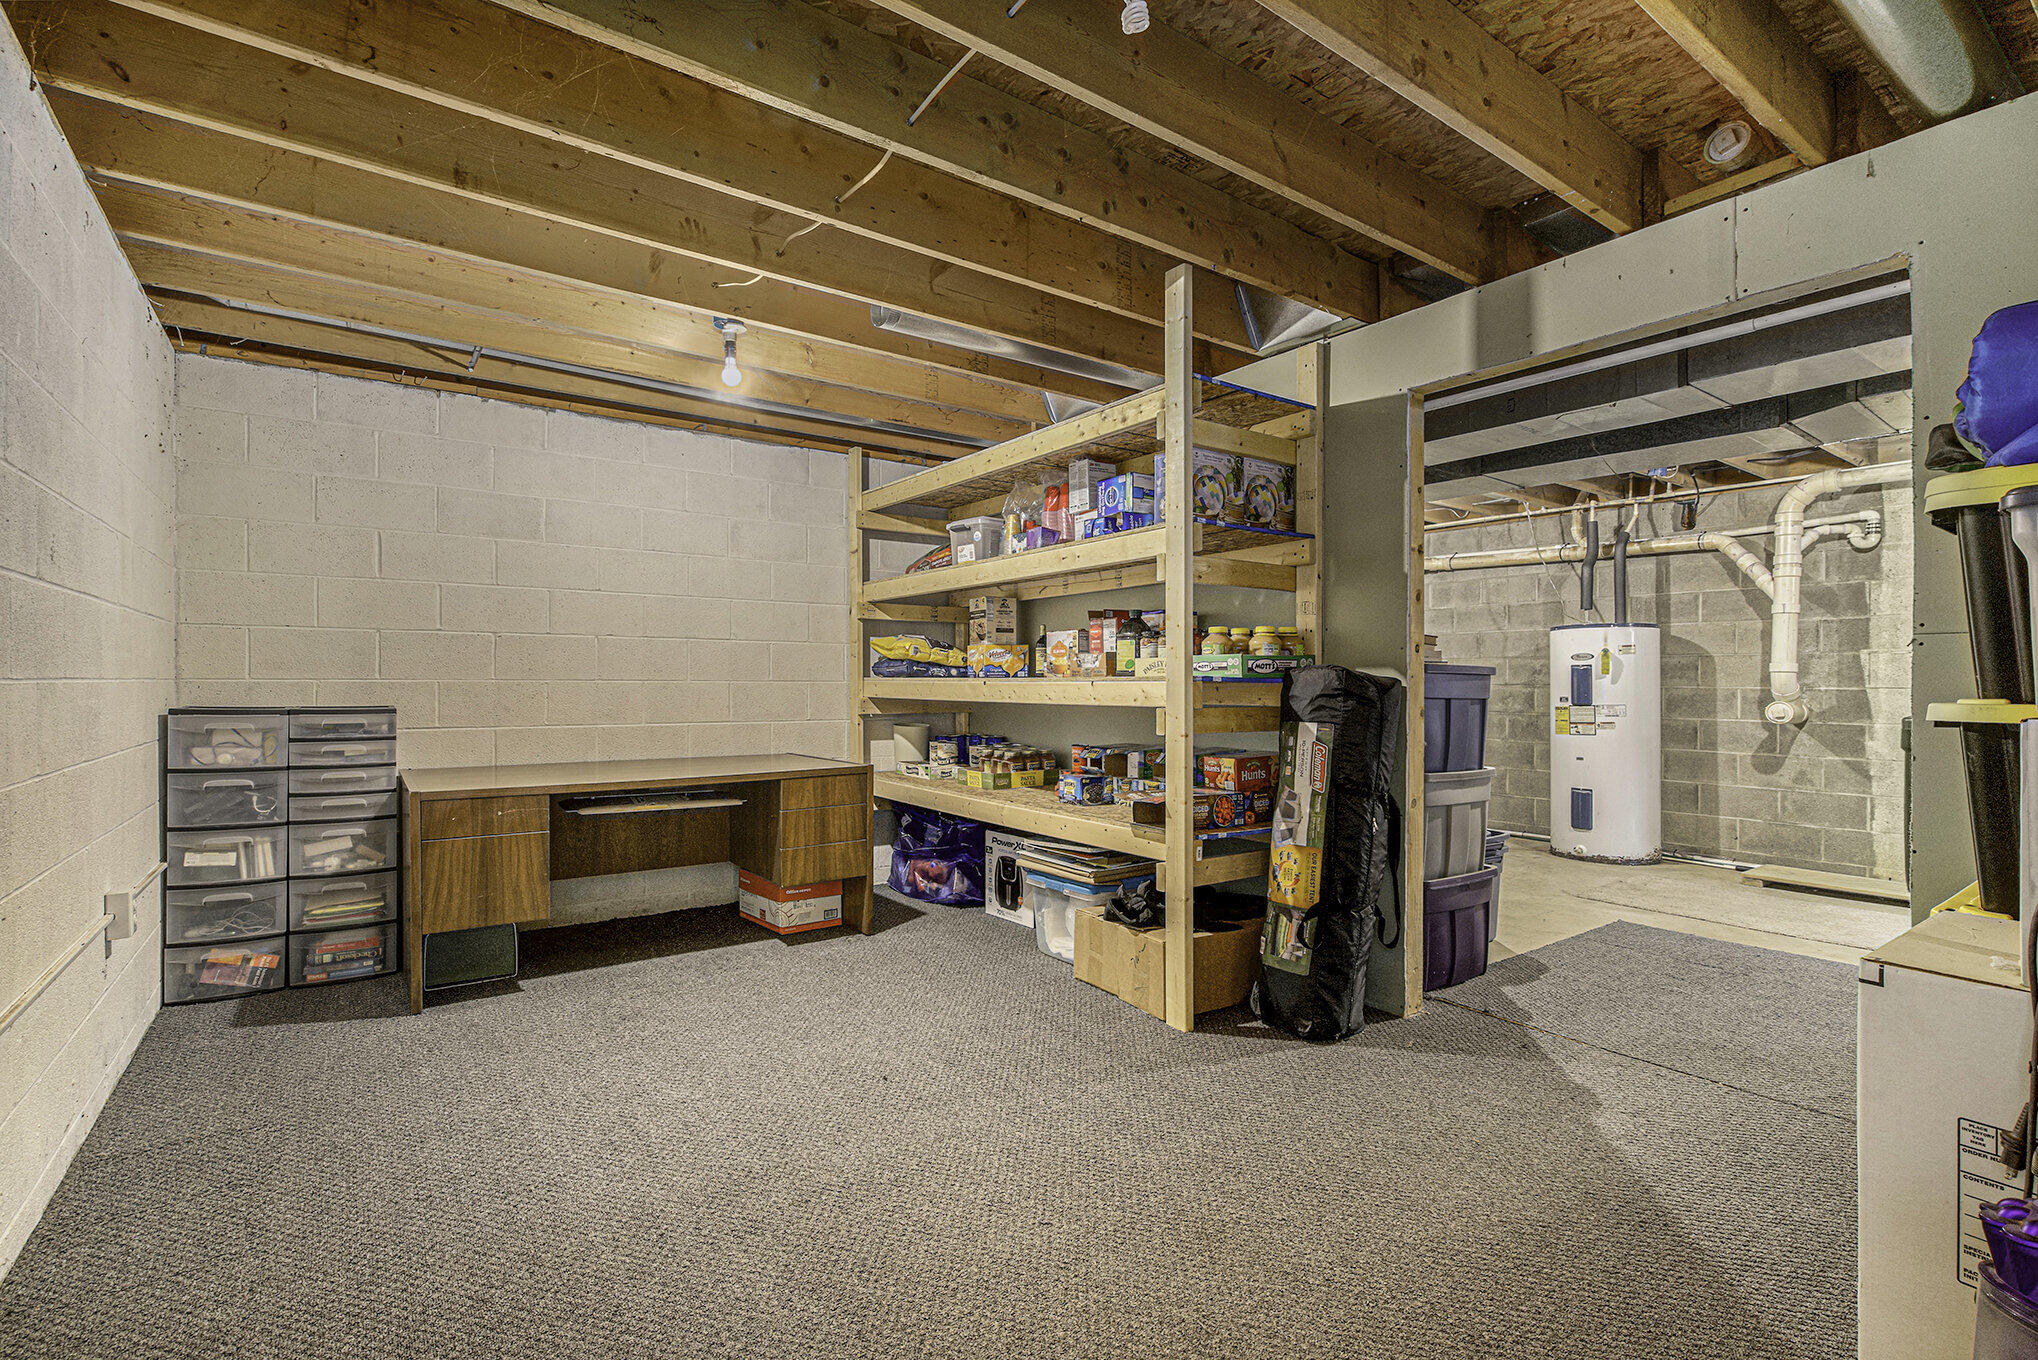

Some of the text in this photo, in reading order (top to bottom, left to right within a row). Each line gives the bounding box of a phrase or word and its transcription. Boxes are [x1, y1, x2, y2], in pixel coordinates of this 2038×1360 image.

[1254, 662, 1276, 671] MOTT'S
[1313, 746, 1326, 781] Coleman
[991, 836, 1027, 851] PowerXL
[1961, 1126, 1995, 1139] INVENTORY
[1968, 1123, 1988, 1132] PLACE
[1970, 1139, 1986, 1147] HERE
[1972, 1134, 1985, 1142] TAG
[1961, 1147, 1988, 1159] ORDER
[1962, 1174, 2005, 1190] CONTENTS
[1963, 1244, 1991, 1257] SPECIA
[1963, 1267, 1979, 1277] PAC
[1963, 1272, 1979, 1282] INIT
